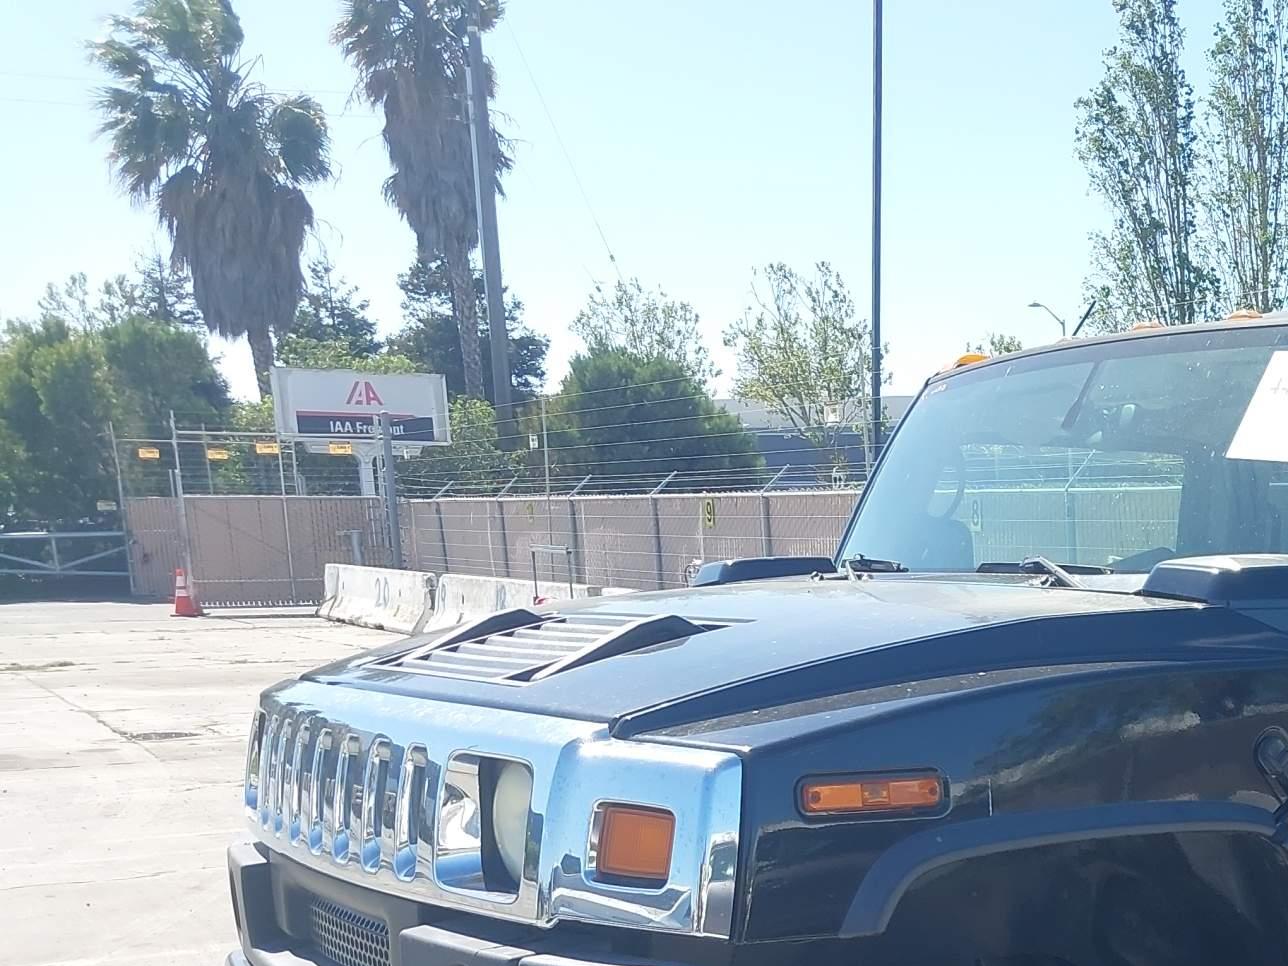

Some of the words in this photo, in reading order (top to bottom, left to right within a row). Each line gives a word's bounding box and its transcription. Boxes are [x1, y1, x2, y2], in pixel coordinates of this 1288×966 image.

[329, 421, 351, 433] IAA
[356, 421, 404, 435] Frent
[972, 500, 979, 526] 8
